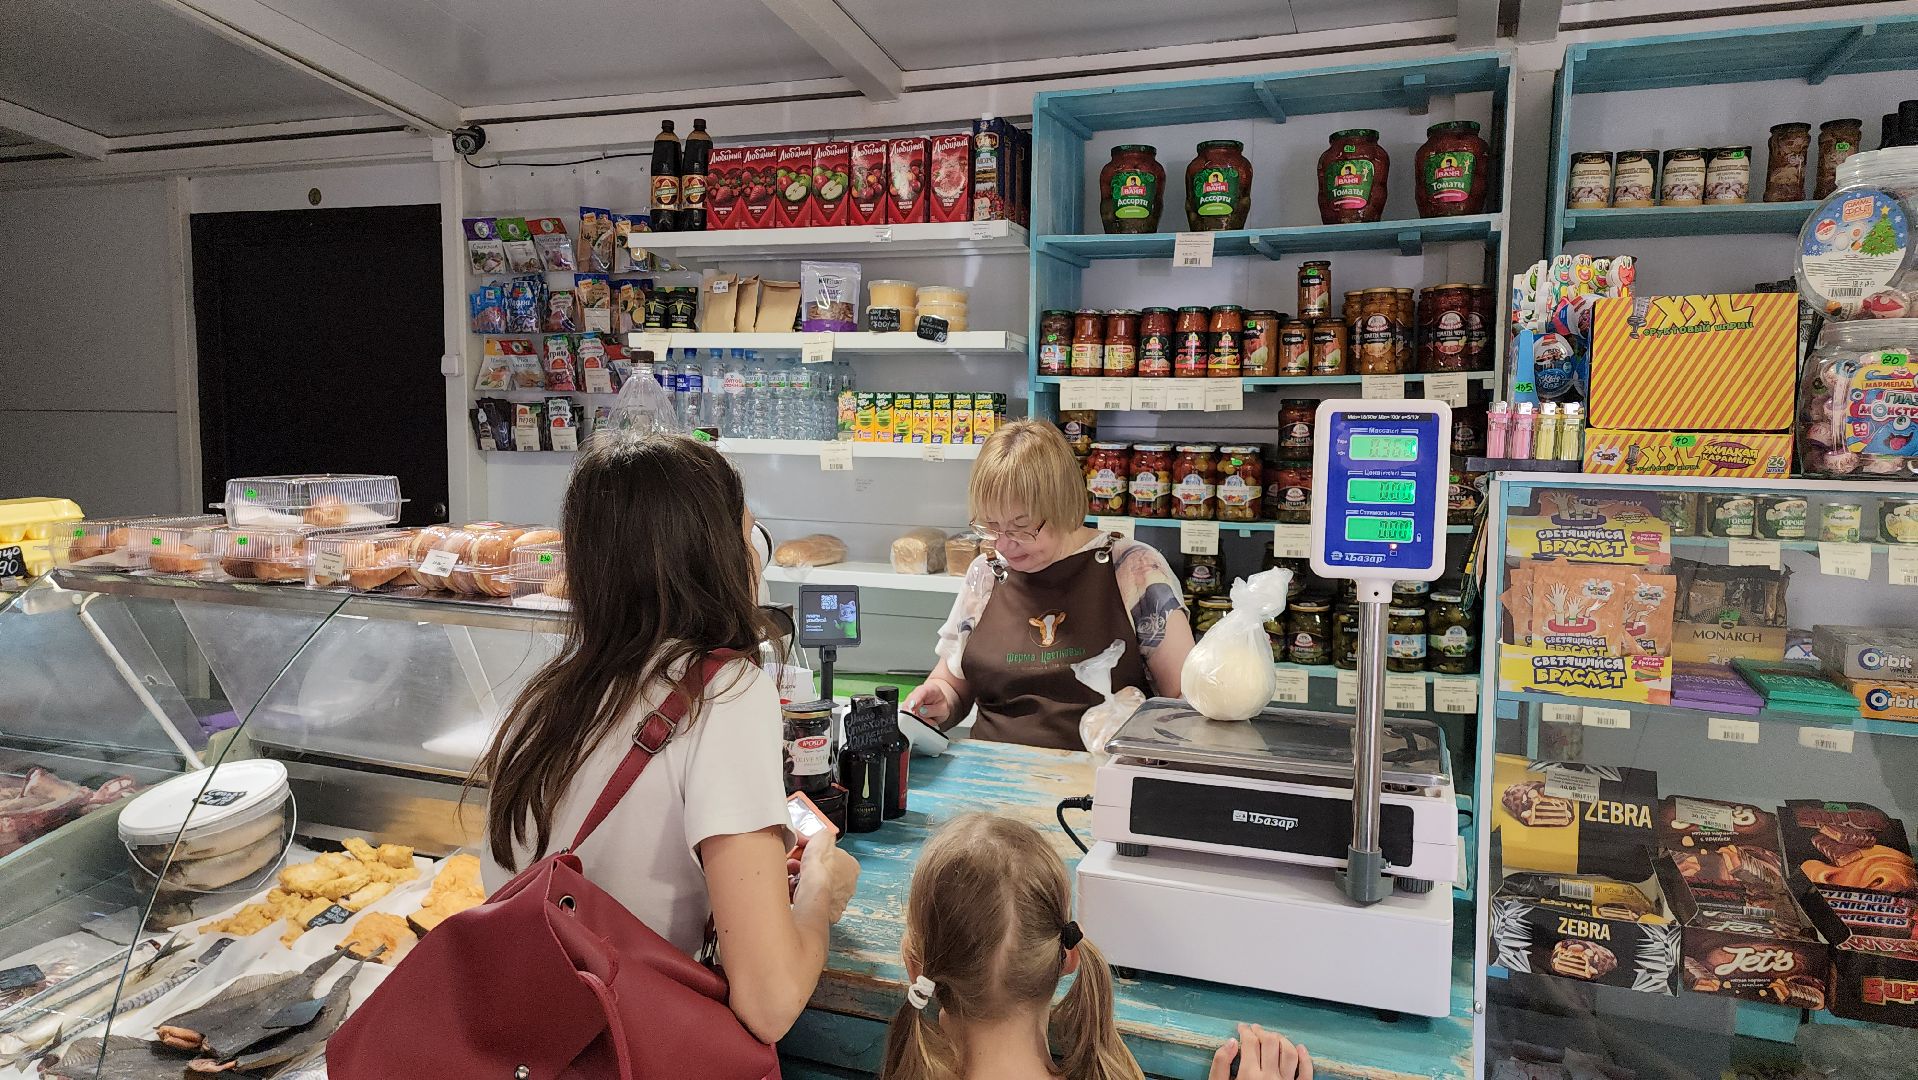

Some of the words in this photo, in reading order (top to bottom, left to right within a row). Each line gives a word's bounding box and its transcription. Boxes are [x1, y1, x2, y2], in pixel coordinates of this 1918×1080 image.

[813, 144, 848, 161] Любимый
[1332, 188, 1363, 197] Томаты
[1432, 181, 1465, 190] Томаты
[1652, 294, 1754, 331] XXL
[1854, 423, 1868, 432] 50
[1640, 445, 1700, 467] XXL
[1703, 444, 1759, 458] ЖИДКАЯ
[1702, 453, 1757, 465] КАРАМЕЛЬ
[1768, 456, 1785, 468] 24
[1537, 527, 1624, 540] СВЕТЯЩИЙСЯ
[1540, 540, 1627, 557] БРАСЛЕТ
[1544, 636, 1606, 646] СВЕТЯЩИЙСЯ
[1692, 629, 1762, 643] MONARCH
[1006, 652, 1036, 664] Ферма
[1532, 656, 1624, 670] СВЕТЯЩИЙСЯ
[1859, 650, 1913, 670] Orbit
[1535, 668, 1627, 688] БРАСЛЕТ
[1584, 800, 1653, 830] ZEBRA
[1830, 900, 1907, 915] SNICKERS
[1557, 916, 1611, 941] ZEBRA
[1714, 946, 1794, 976] Jet's
